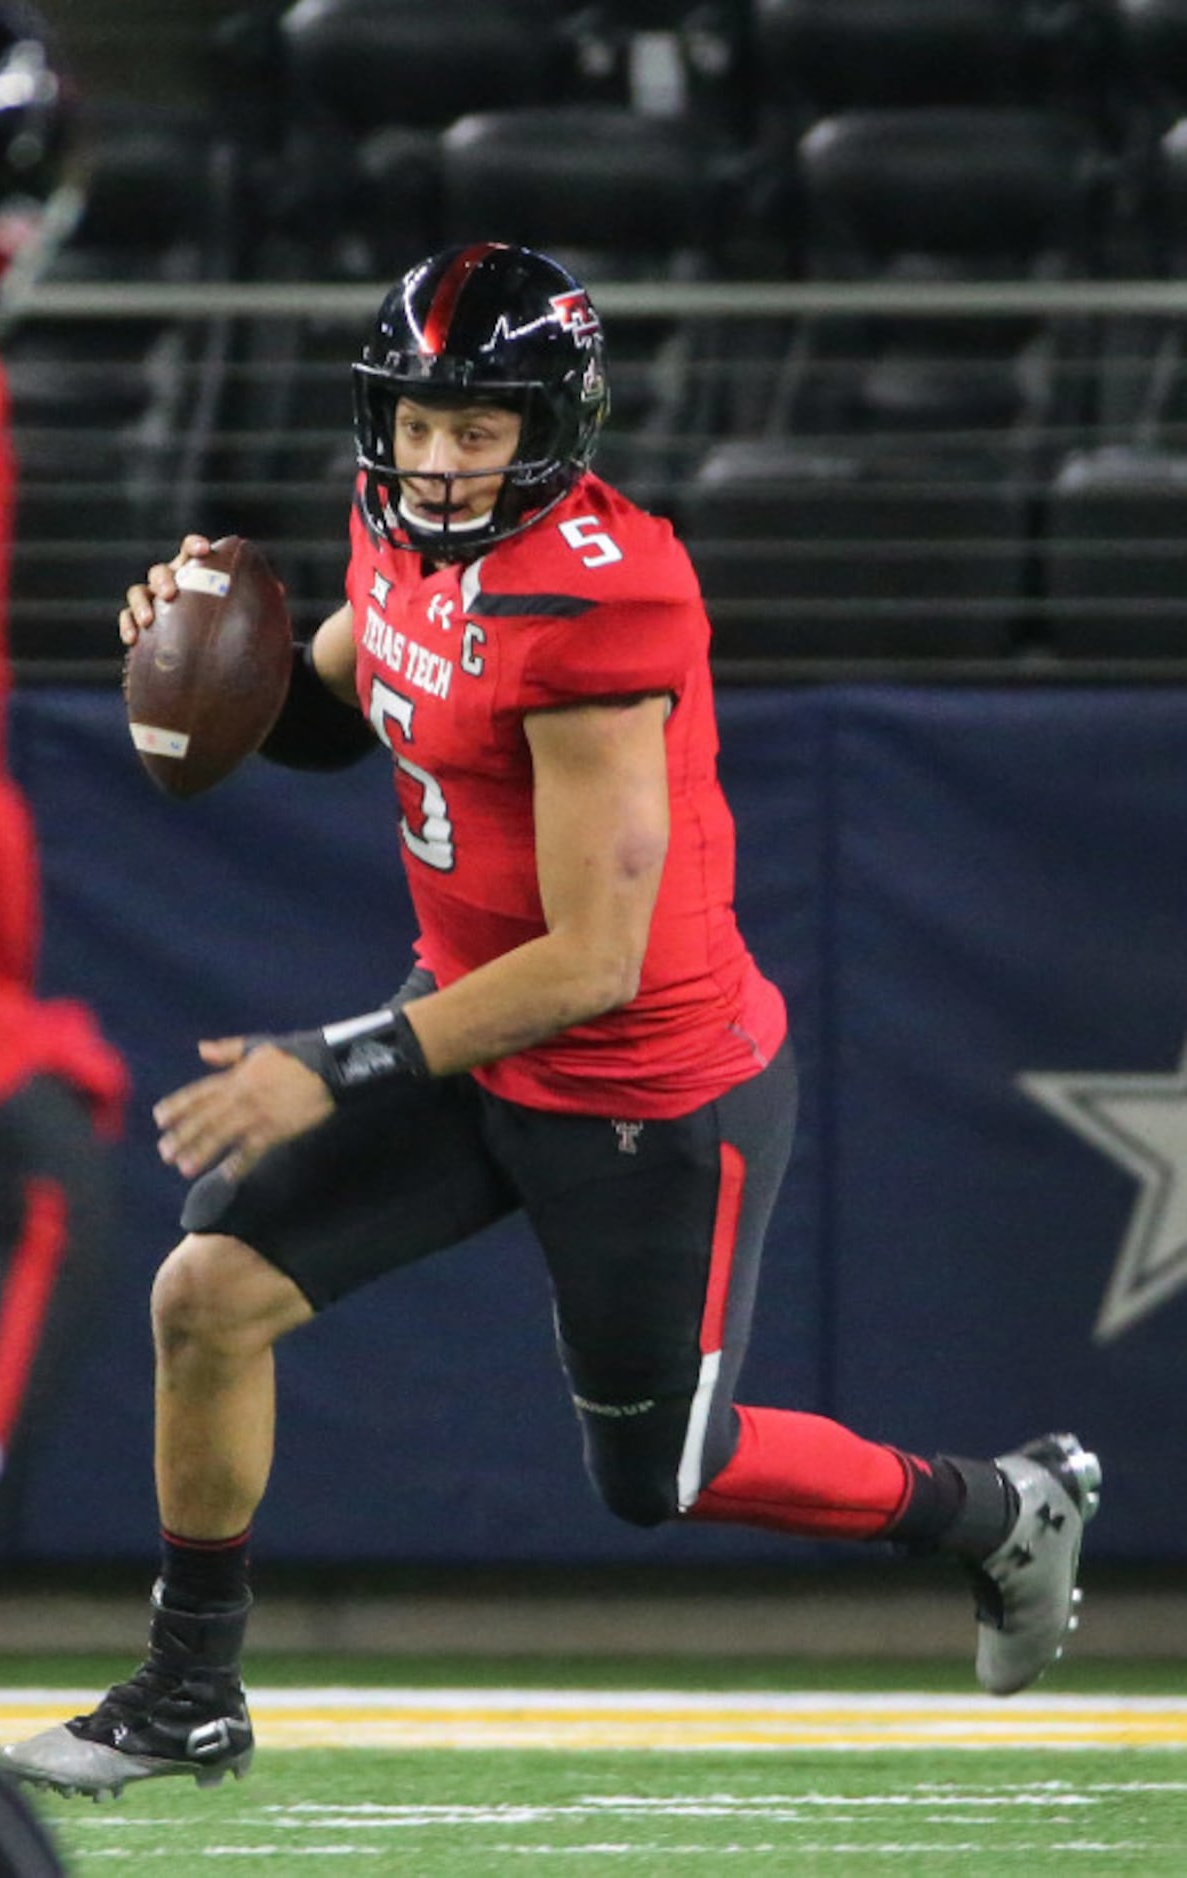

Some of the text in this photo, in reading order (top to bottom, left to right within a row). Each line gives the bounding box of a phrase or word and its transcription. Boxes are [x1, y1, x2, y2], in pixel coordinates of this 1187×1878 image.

[558, 515, 624, 568] 5
[362, 606, 454, 701] TEXAS TECH
[460, 620, 487, 677] C
[368, 675, 456, 872] 5
